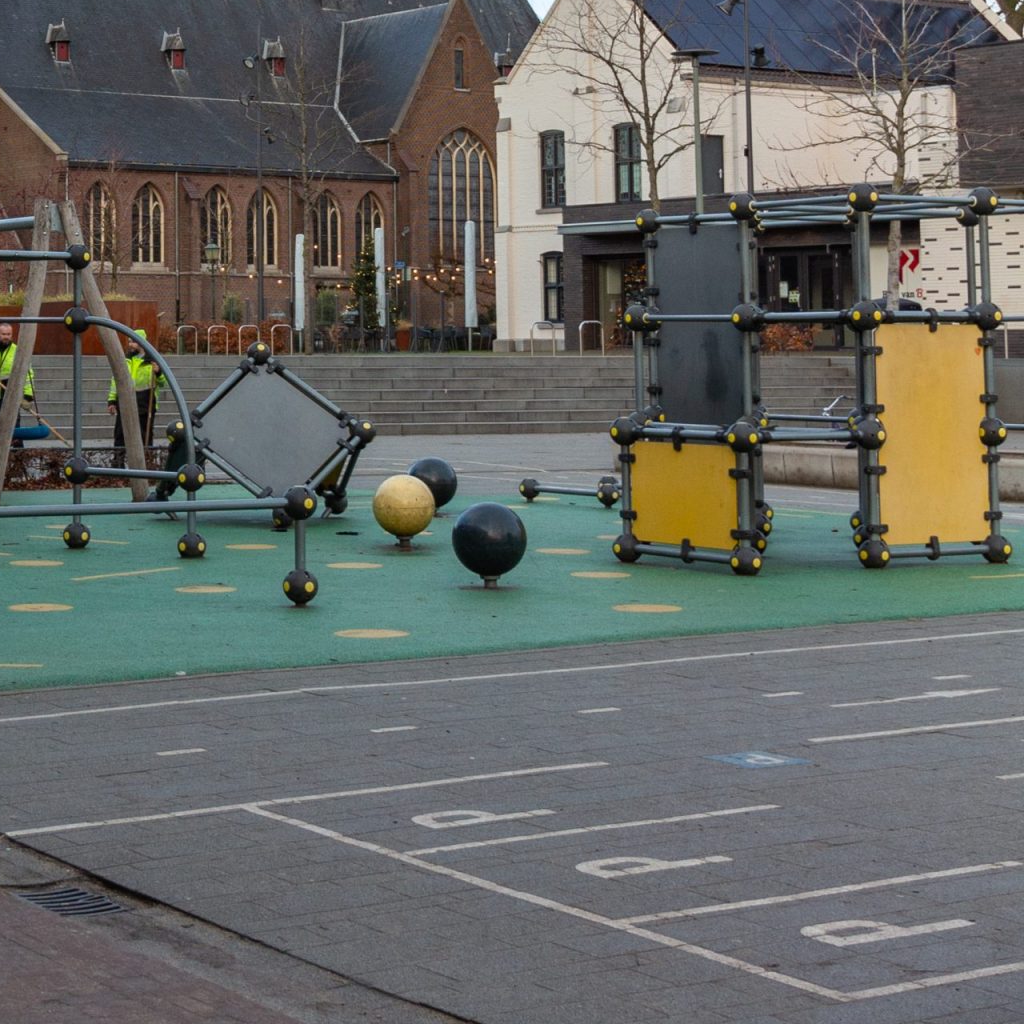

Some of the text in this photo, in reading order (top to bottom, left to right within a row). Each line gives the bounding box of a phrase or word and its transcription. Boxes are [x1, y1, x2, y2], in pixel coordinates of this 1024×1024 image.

[411, 808, 556, 829] P
[576, 855, 733, 879] P
[800, 919, 976, 947] P
